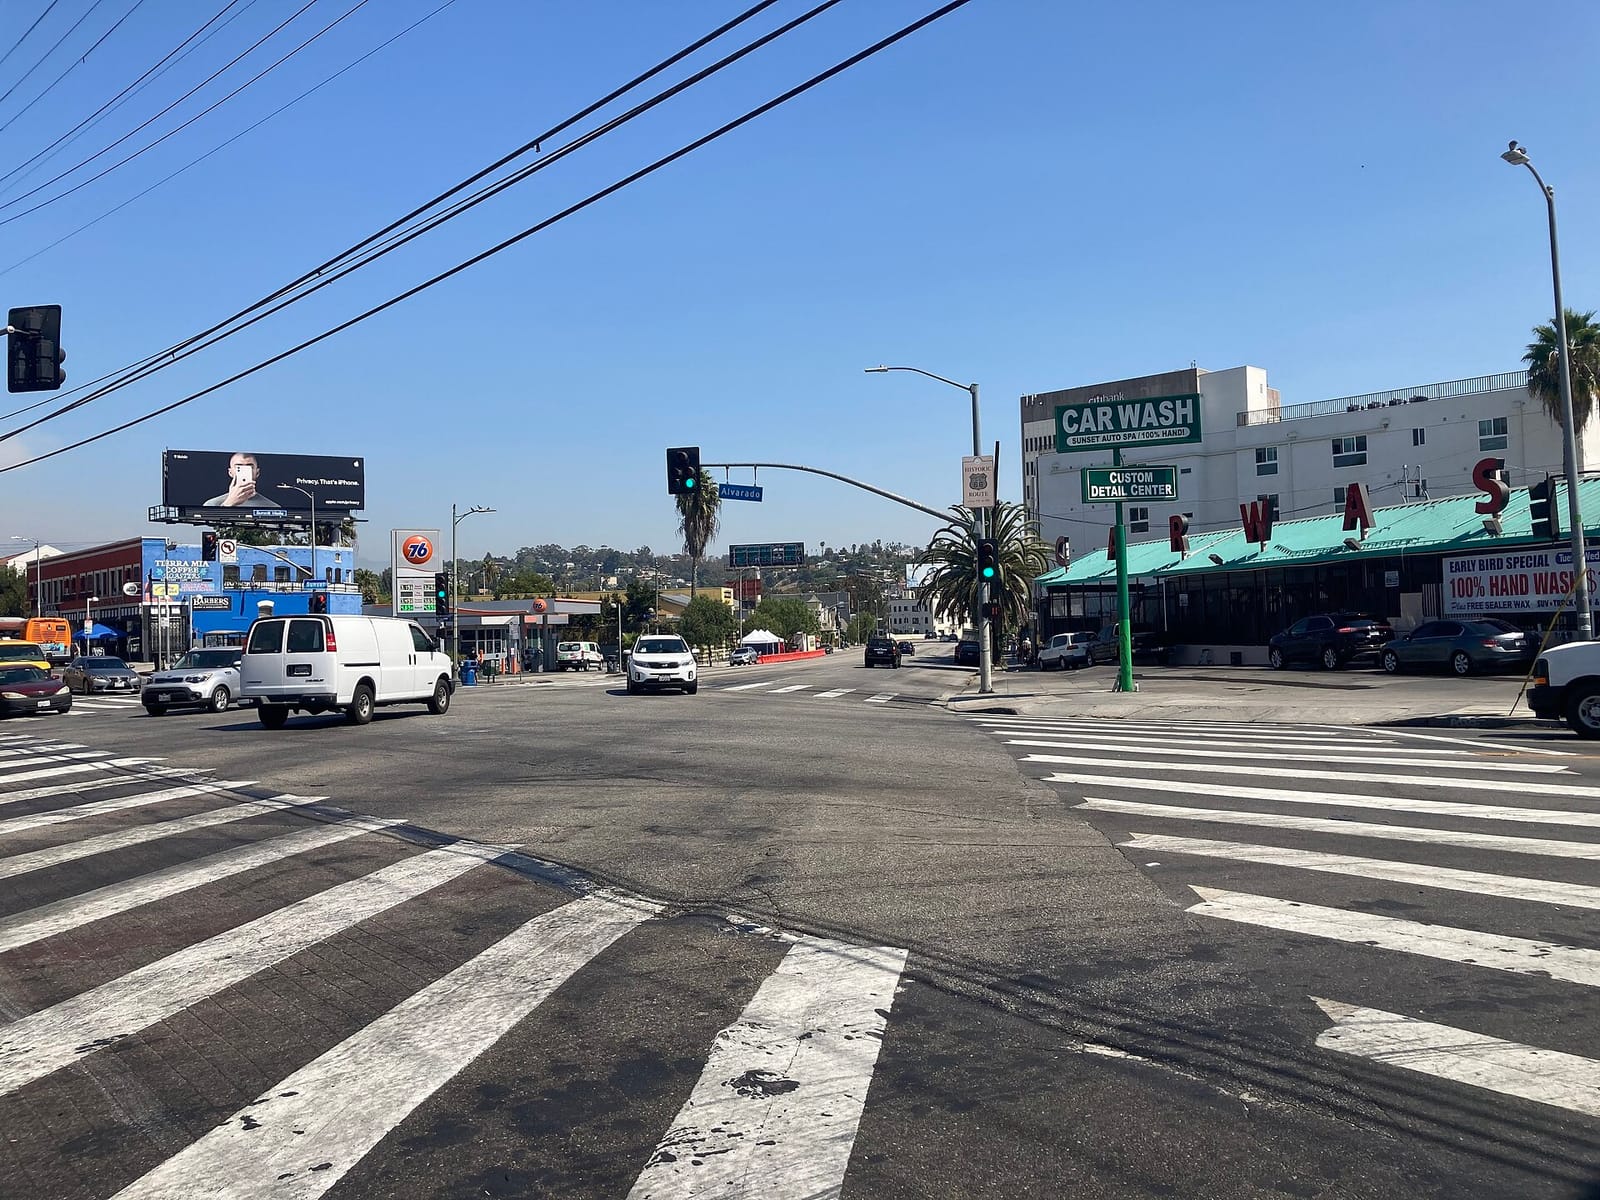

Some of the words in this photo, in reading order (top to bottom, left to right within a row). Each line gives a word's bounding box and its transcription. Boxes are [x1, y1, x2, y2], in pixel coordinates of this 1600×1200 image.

[1062, 406, 1114, 434] CAR
[1117, 399, 1194, 429] WASH
[1072, 435, 1100, 445] SUNSET
[1102, 433, 1121, 442] AUTO
[1123, 432, 1137, 440] SPA
[1141, 430, 1160, 439] 100%
[1162, 429, 1185, 437] HAND!
[296, 478, 319, 486] Privacy.
[1109, 472, 1153, 484] CUSTOM
[720, 488, 761, 499] Alvarado
[1091, 485, 1126, 497] DETAIL
[1130, 484, 1172, 496] CENTER
[408, 542, 429, 559] 76
[1449, 559, 1477, 573] EARLY
[1478, 557, 1504, 571] BIRD
[1505, 554, 1550, 570] SPECIAL
[1449, 575, 1485, 598] 100%
[1489, 573, 1529, 597] HAND
[193, 596, 229, 606] BARBERS
[1467, 601, 1485, 610] FREE
[1485, 600, 1513, 609] SEALER
[1513, 599, 1531, 609] WAX
